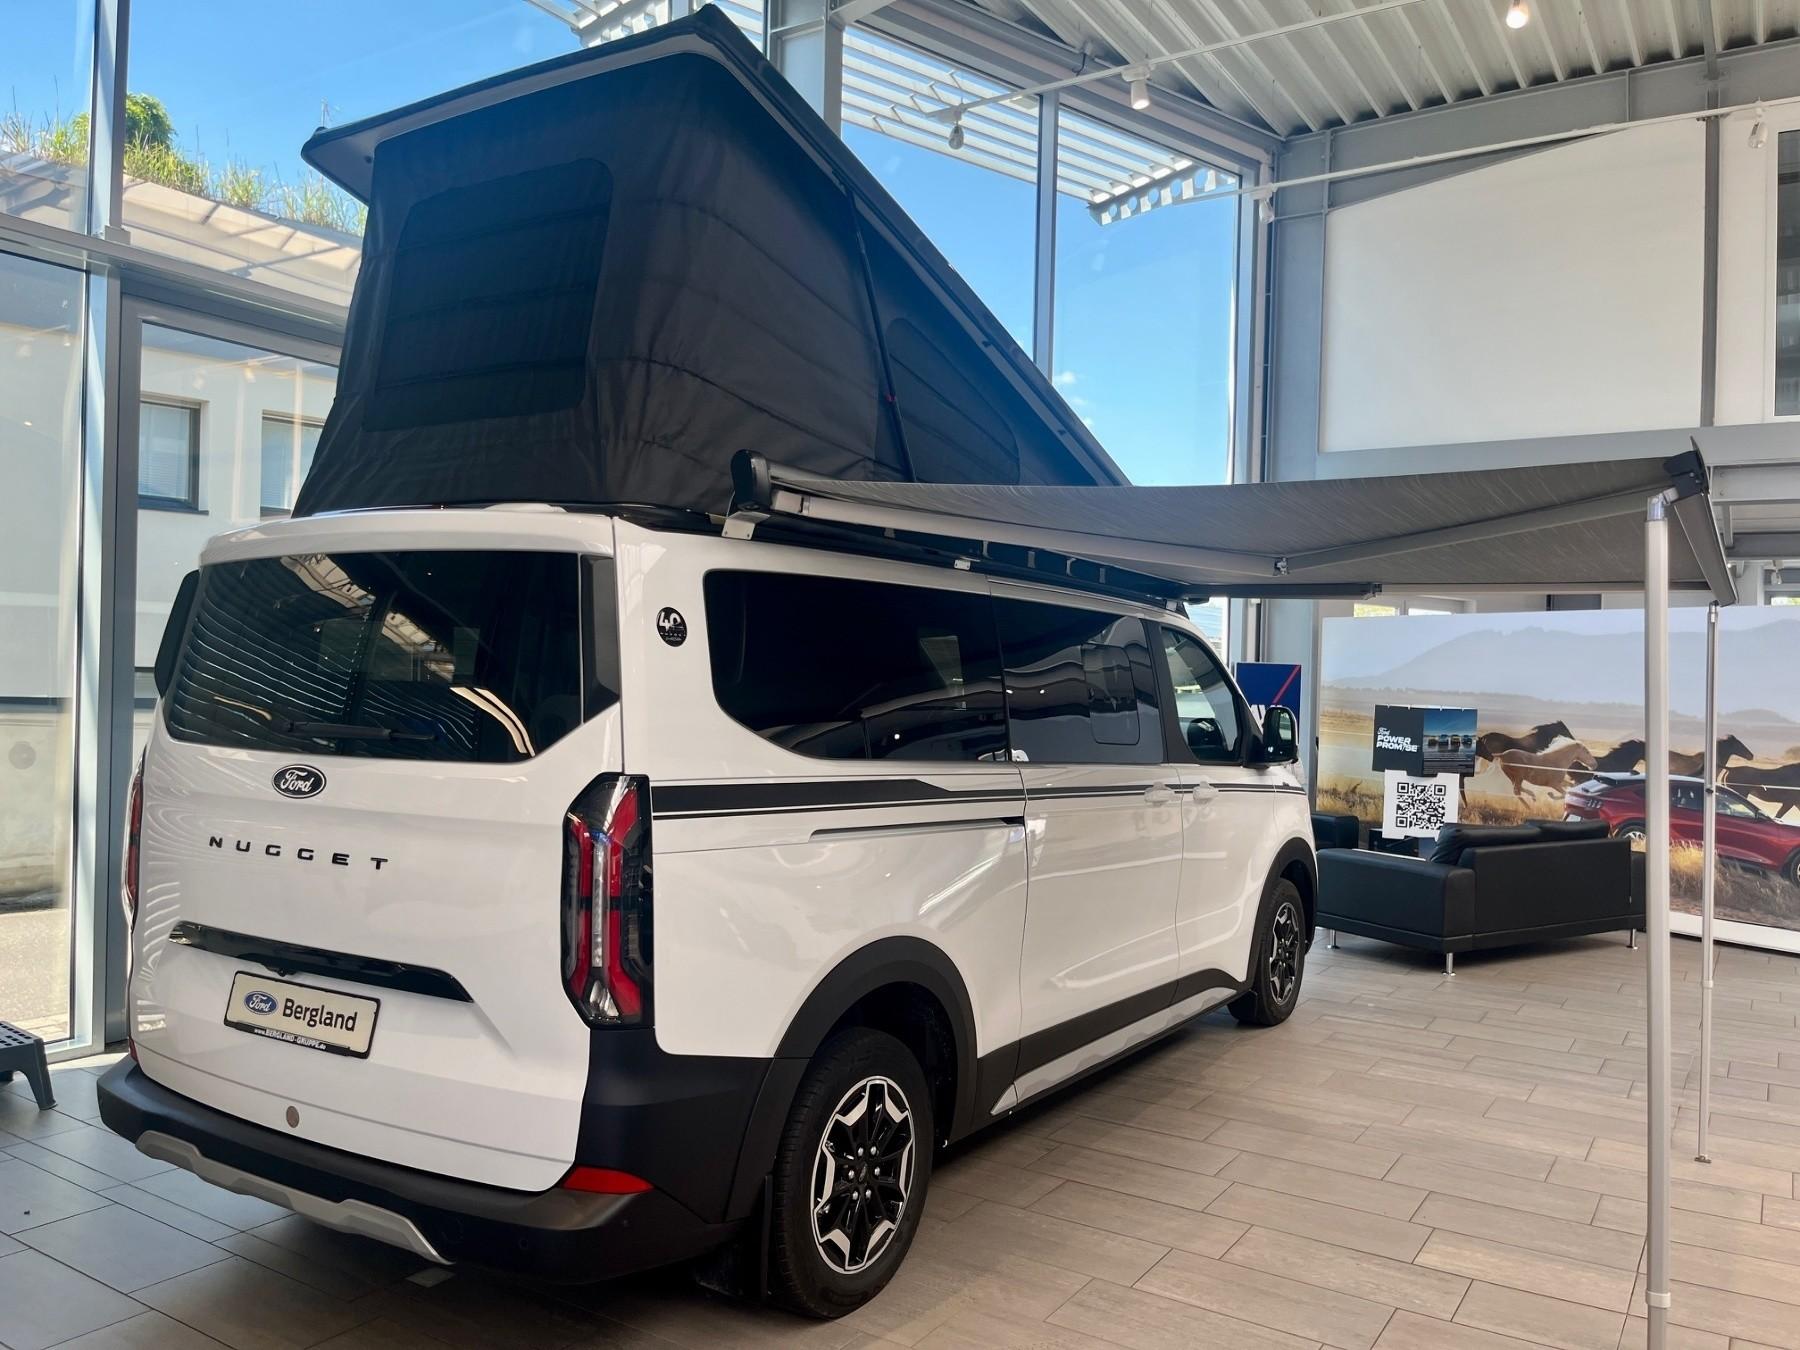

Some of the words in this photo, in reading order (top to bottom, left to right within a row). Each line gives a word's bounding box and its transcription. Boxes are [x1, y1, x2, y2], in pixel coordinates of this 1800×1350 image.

[1377, 735, 1412, 746] POWER
[280, 769, 315, 792] Ford
[209, 836, 388, 870] NUGGET
[249, 994, 271, 1012] Ford
[282, 998, 358, 1032] Bergland
